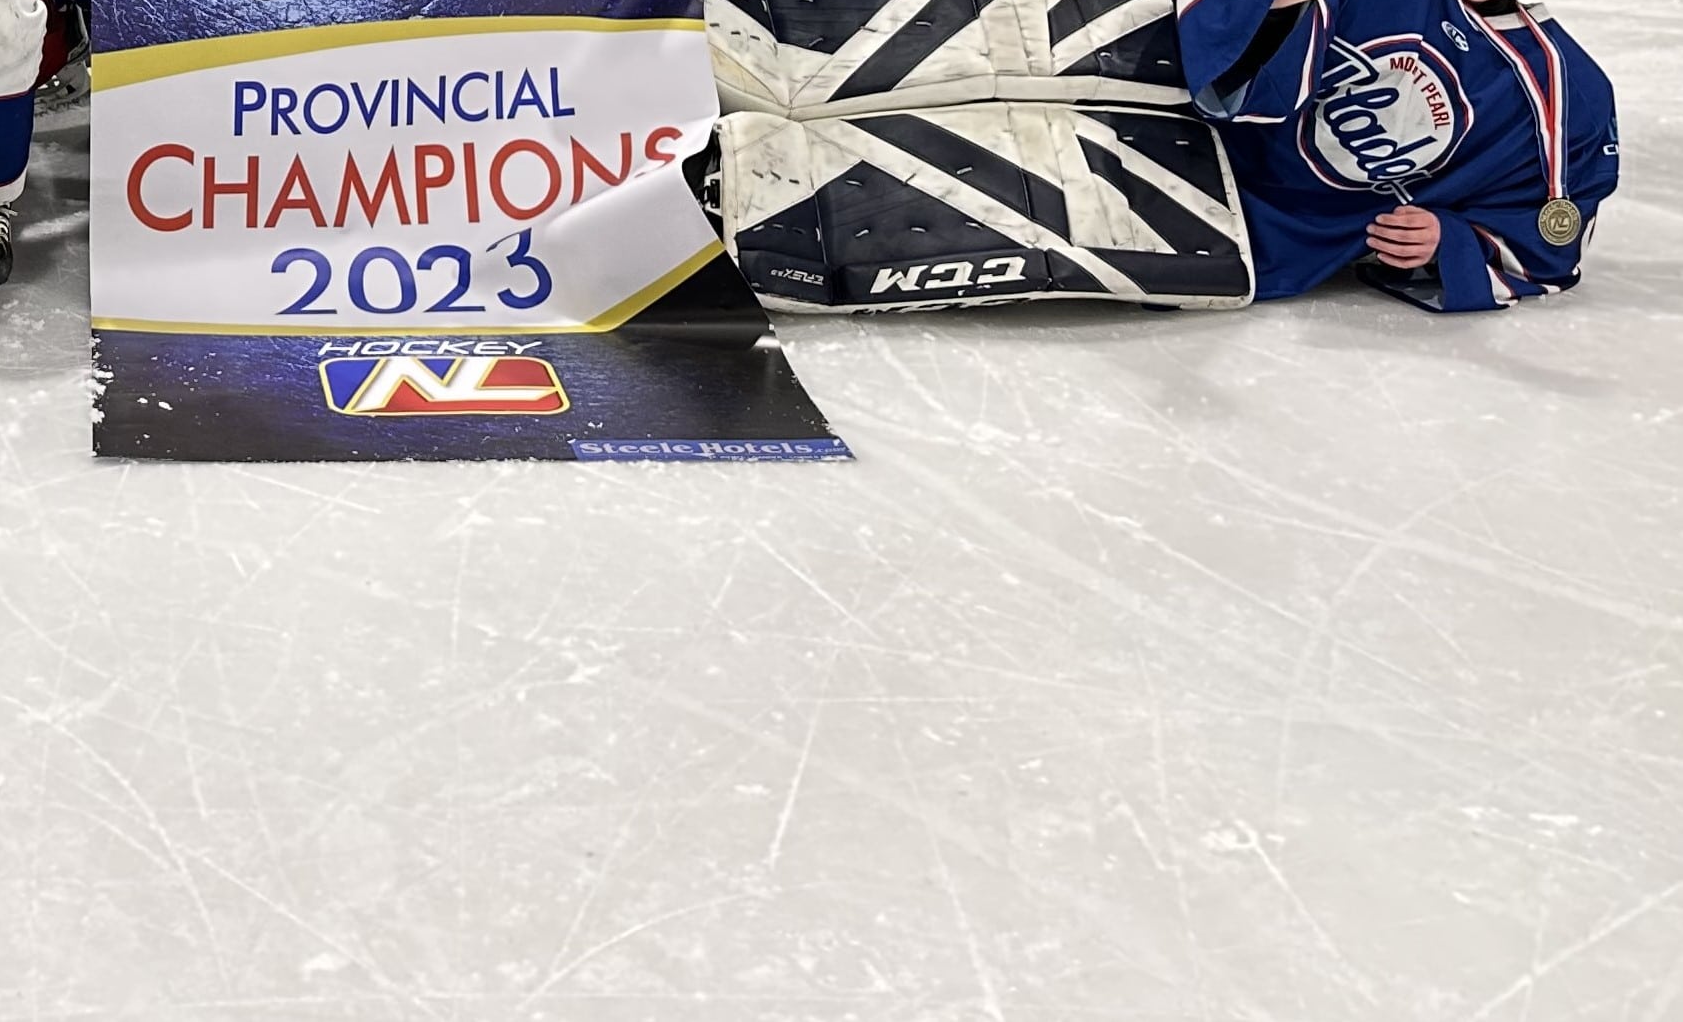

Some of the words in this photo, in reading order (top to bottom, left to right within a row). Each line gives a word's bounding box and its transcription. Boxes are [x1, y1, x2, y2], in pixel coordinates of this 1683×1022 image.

[232, 66, 576, 137] PROVINCIAL
[1421, 81, 1451, 131] PEARL
[271, 228, 554, 316] 2023
[869, 256, 1027, 294] CCM
[318, 340, 543, 356] HOCKEY
[579, 441, 694, 455] Steele
